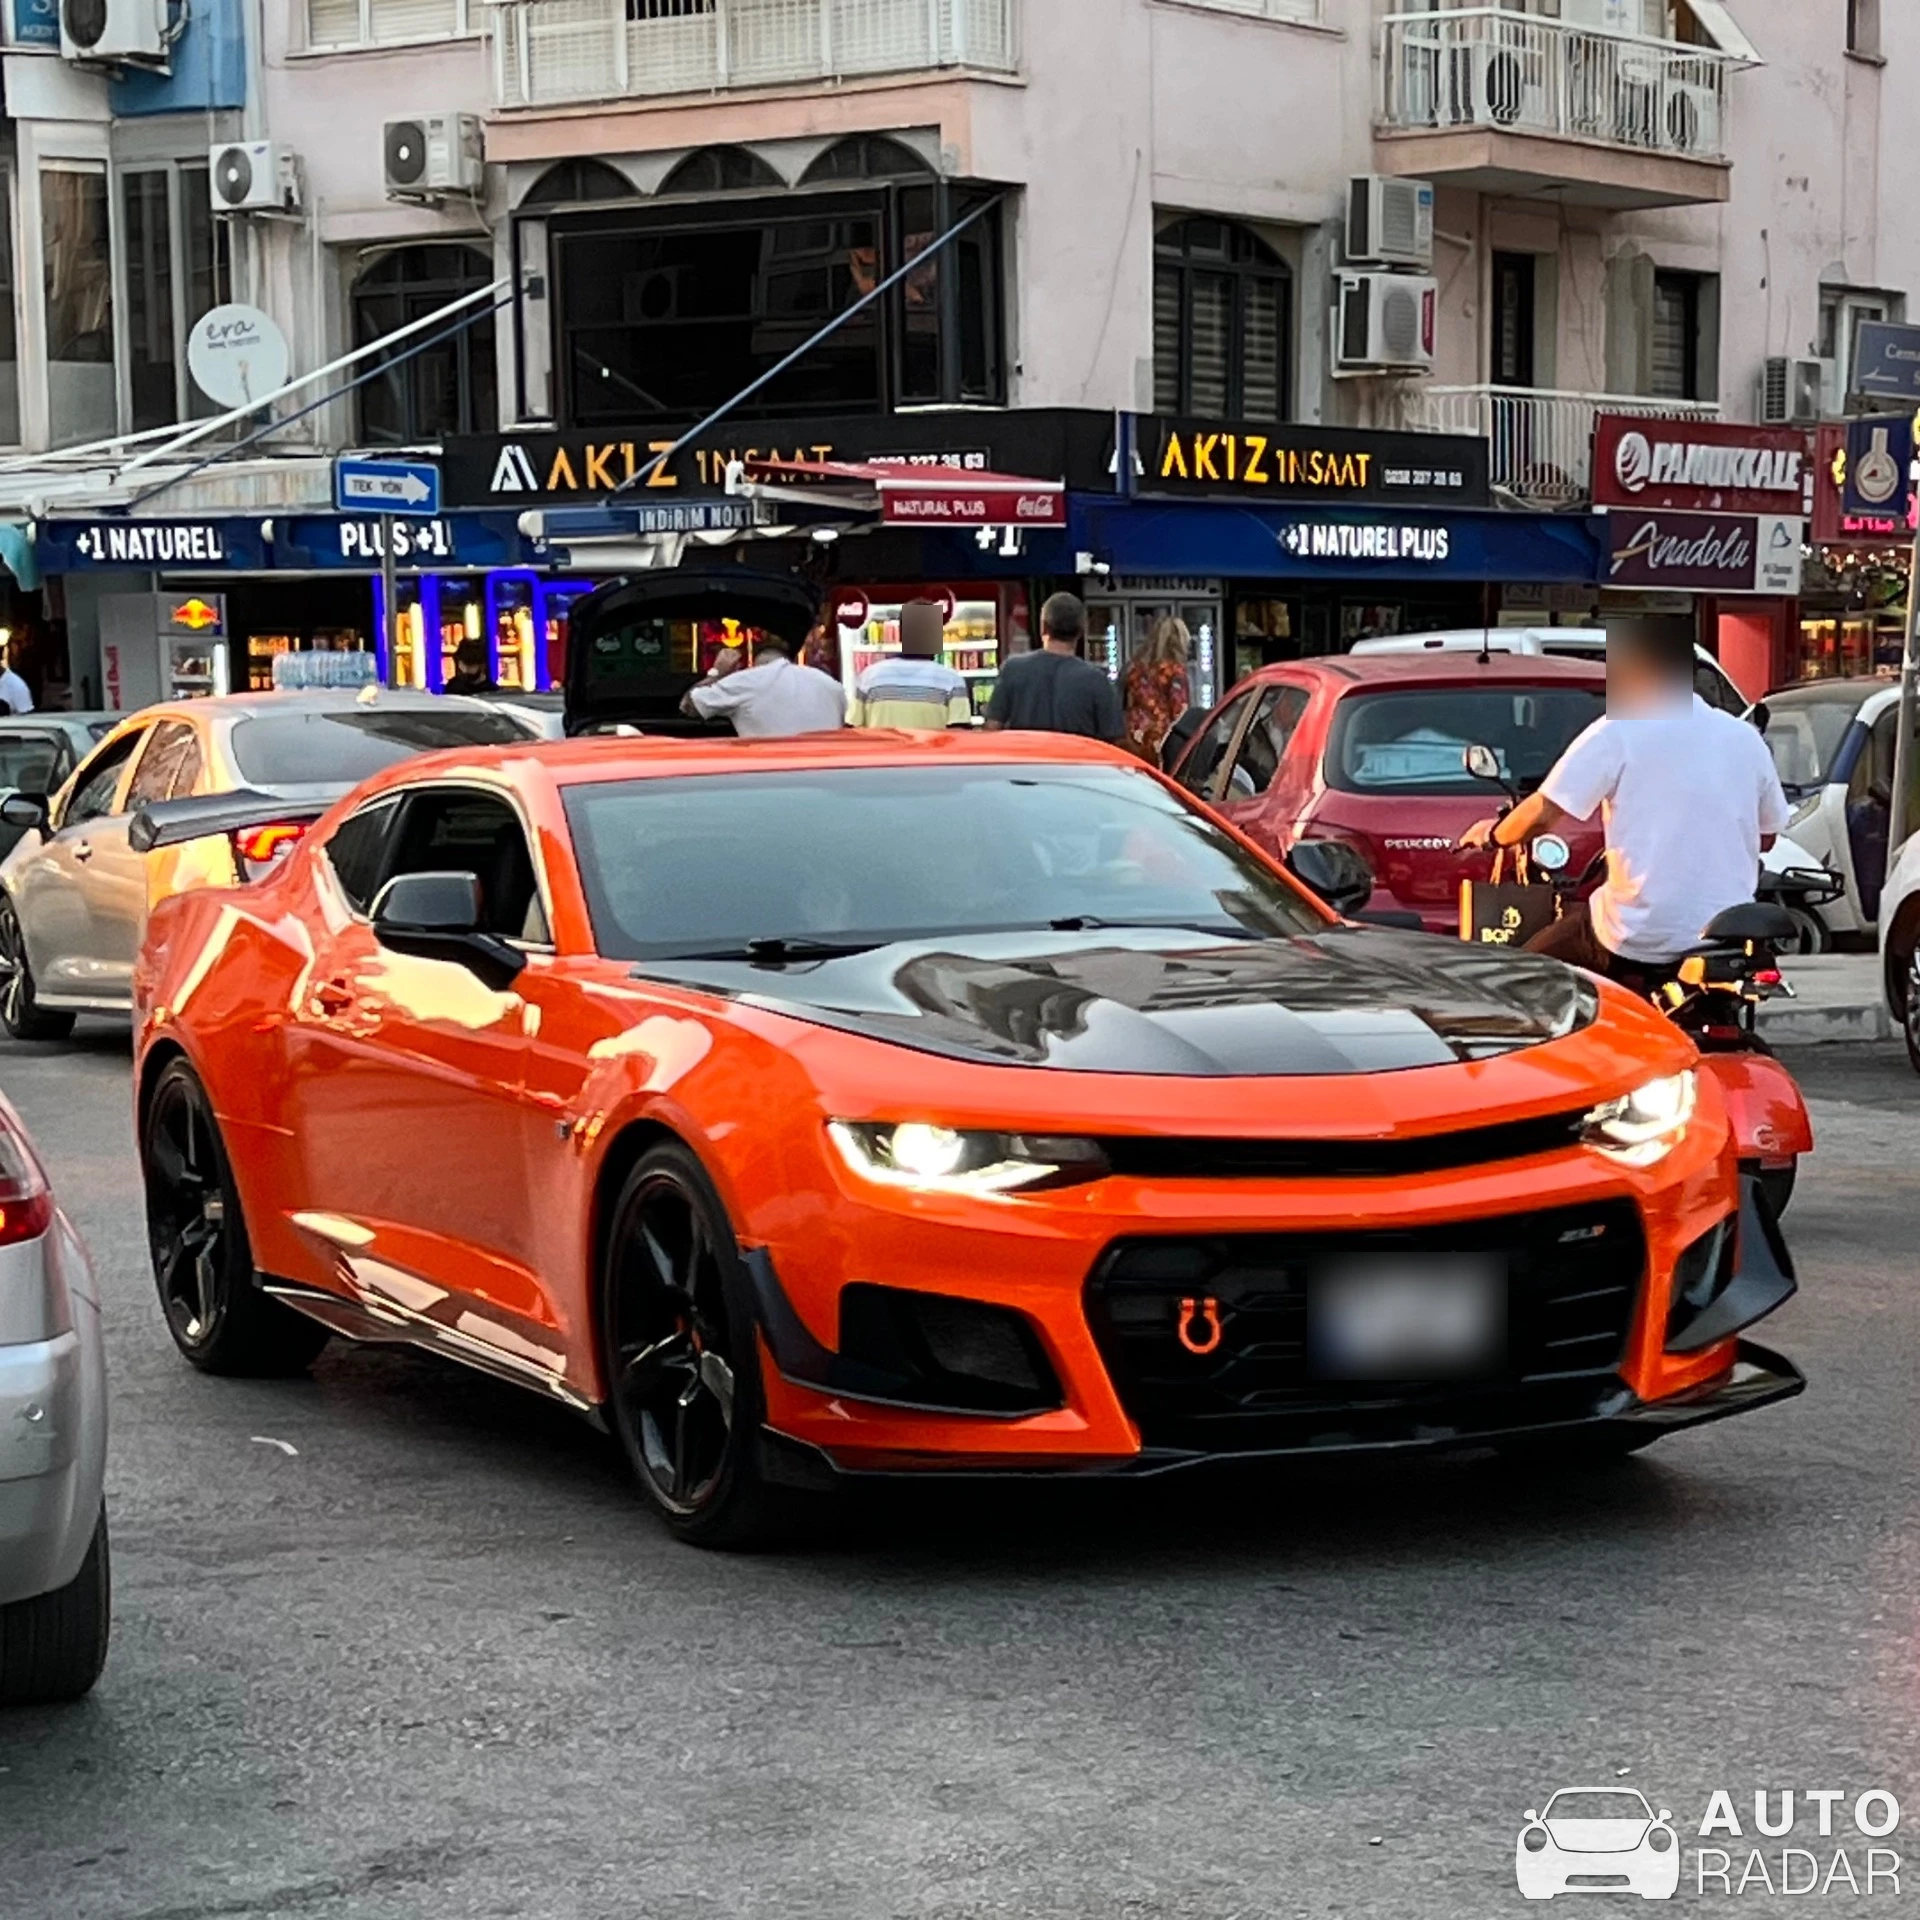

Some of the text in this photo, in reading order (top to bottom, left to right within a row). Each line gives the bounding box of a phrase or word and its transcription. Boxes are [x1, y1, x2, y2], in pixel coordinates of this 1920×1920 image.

[1650, 442, 1803, 491] PAMUKKALE
[352, 478, 403, 494] TEK YÖN
[893, 500, 986, 516] NATURAL PLUS
[110, 526, 223, 560] NATUREL
[1312, 525, 1399, 558] NATUREL
[1401, 527, 1449, 560] PLUS
[1609, 521, 1750, 575] Anadolu
